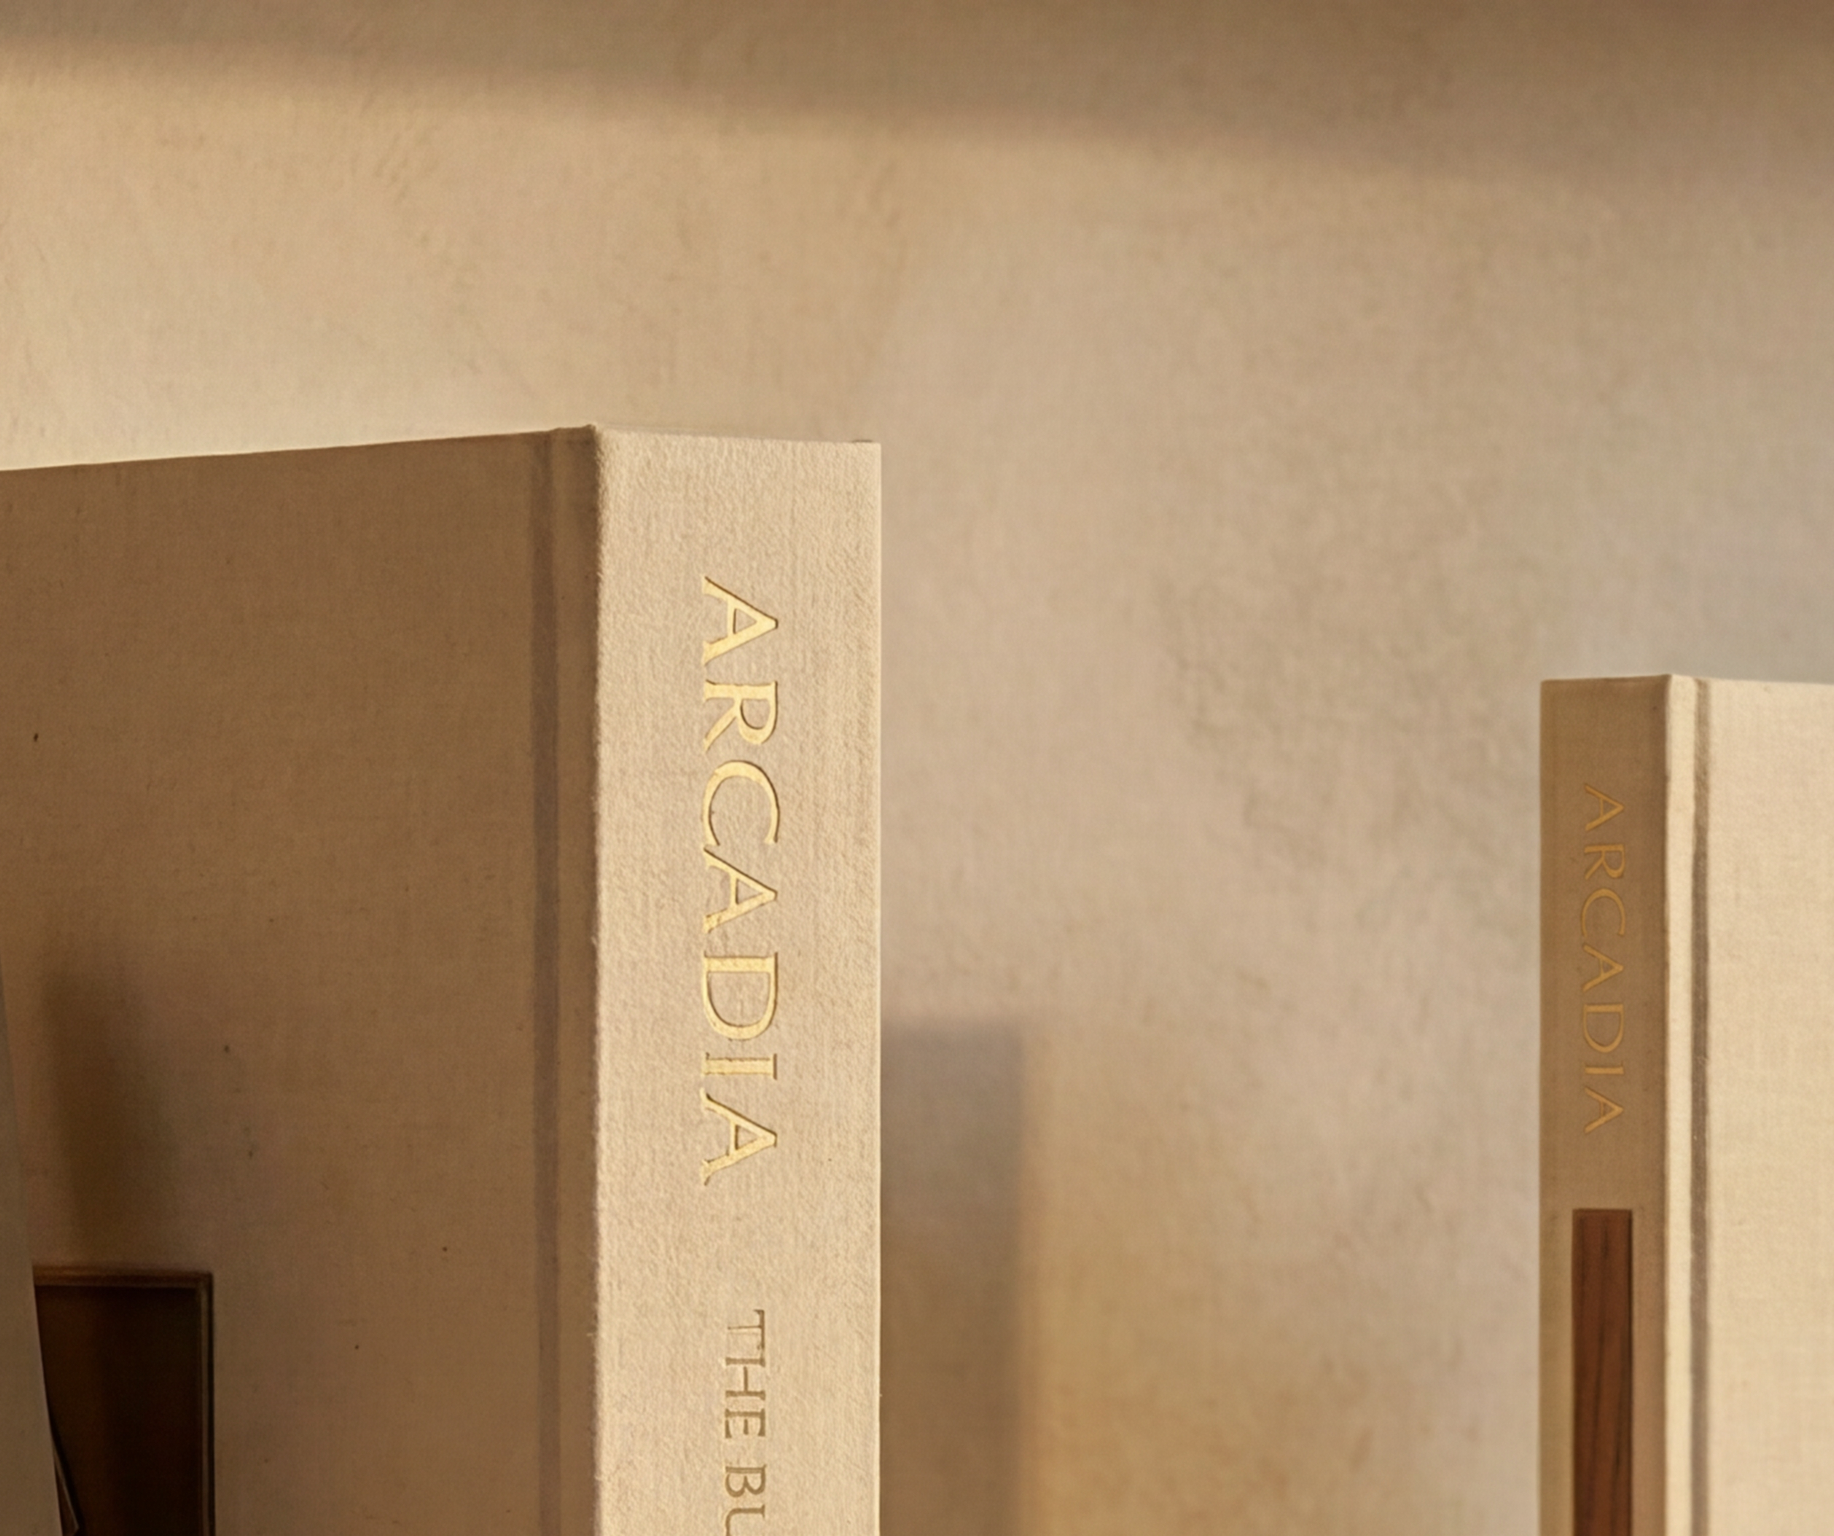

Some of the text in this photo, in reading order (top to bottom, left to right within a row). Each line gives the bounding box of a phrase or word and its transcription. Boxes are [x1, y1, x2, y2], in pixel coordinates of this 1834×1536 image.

[701, 576, 779, 1185] ARCADIA
[1580, 784, 1625, 1134] ARCADIA
[724, 1309, 766, 1440] THE
